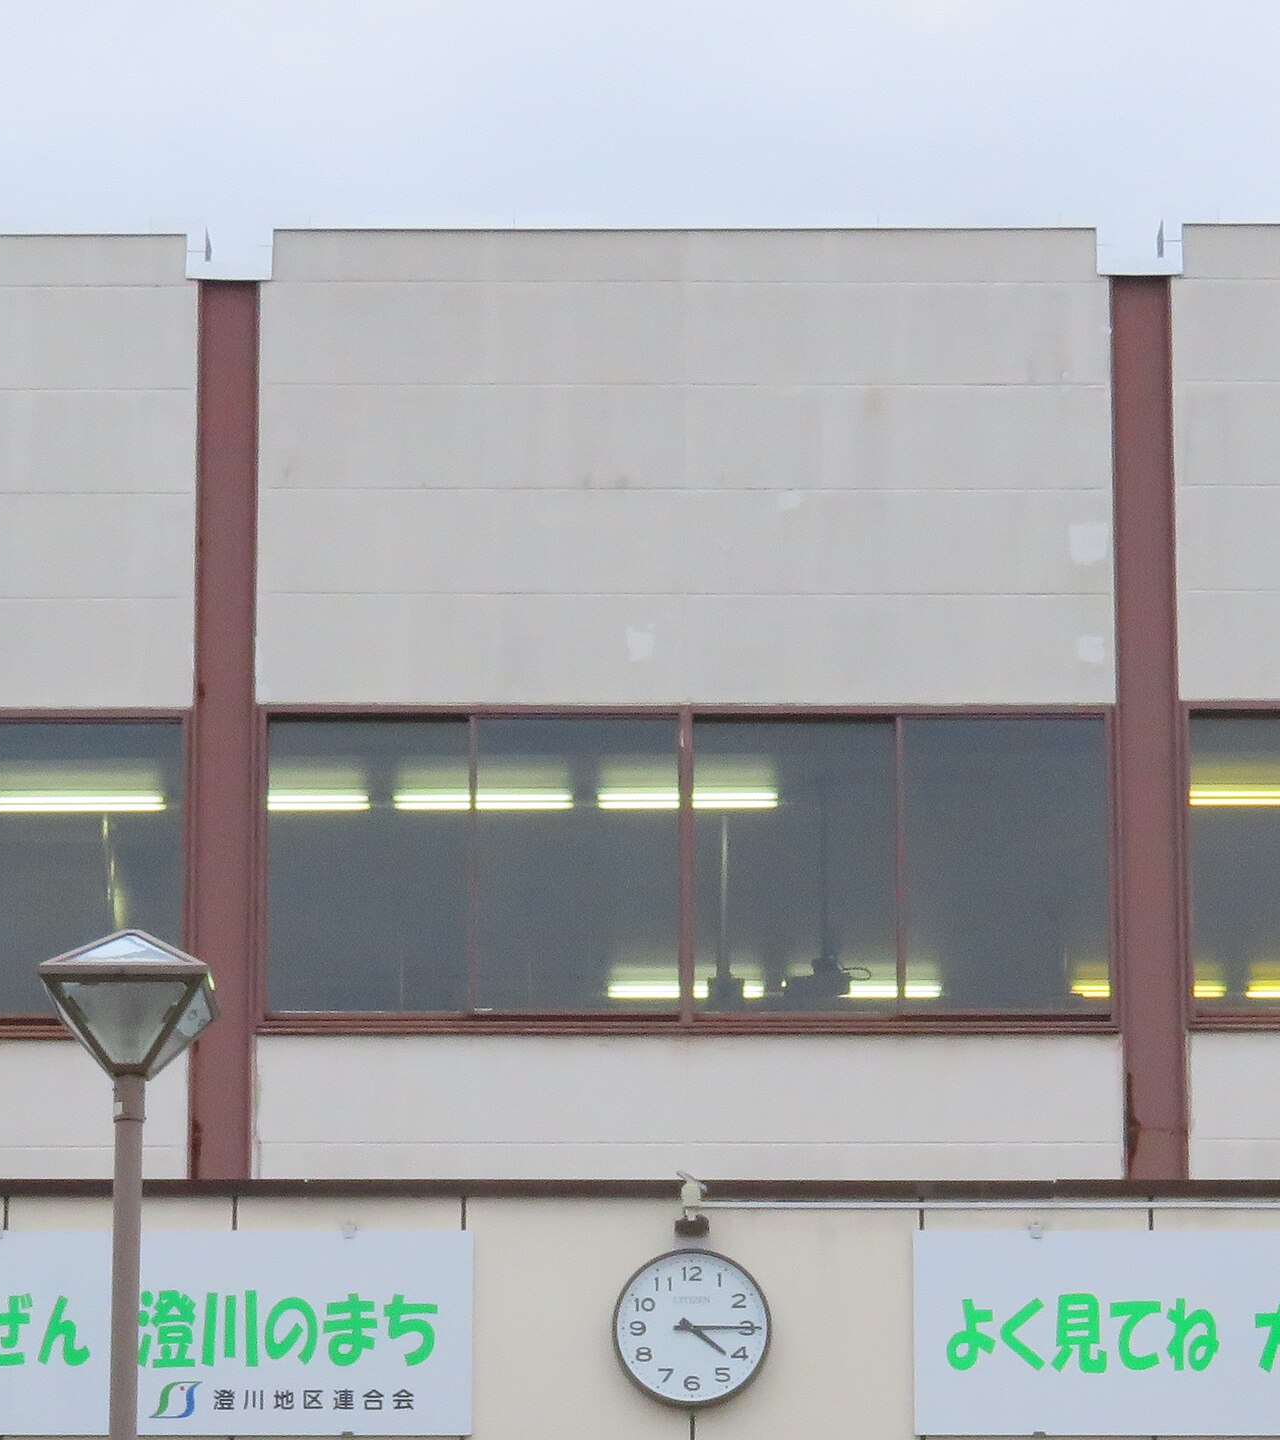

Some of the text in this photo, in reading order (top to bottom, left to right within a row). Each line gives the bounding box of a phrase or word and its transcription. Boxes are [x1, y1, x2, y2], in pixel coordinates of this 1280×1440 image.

[681, 1266, 703, 1282] 12
[716, 1272, 722, 1287] 1
[654, 1276, 672, 1292] 11
[633, 1297, 656, 1312] 10
[731, 1293, 747, 1309] 2
[138, 1290, 438, 1368] 澄川のまち
[629, 1320, 647, 1336] 9
[738, 1320, 755, 1336] 3
[946, 1293, 1220, 1373] よく見てね
[635, 1347, 653, 1363] 8
[730, 1346, 749, 1361] 4
[657, 1367, 675, 1383] 7
[714, 1367, 731, 1383] 5
[683, 1375, 701, 1392] 6
[213, 1388, 414, 1411] 澄川地区連合会
